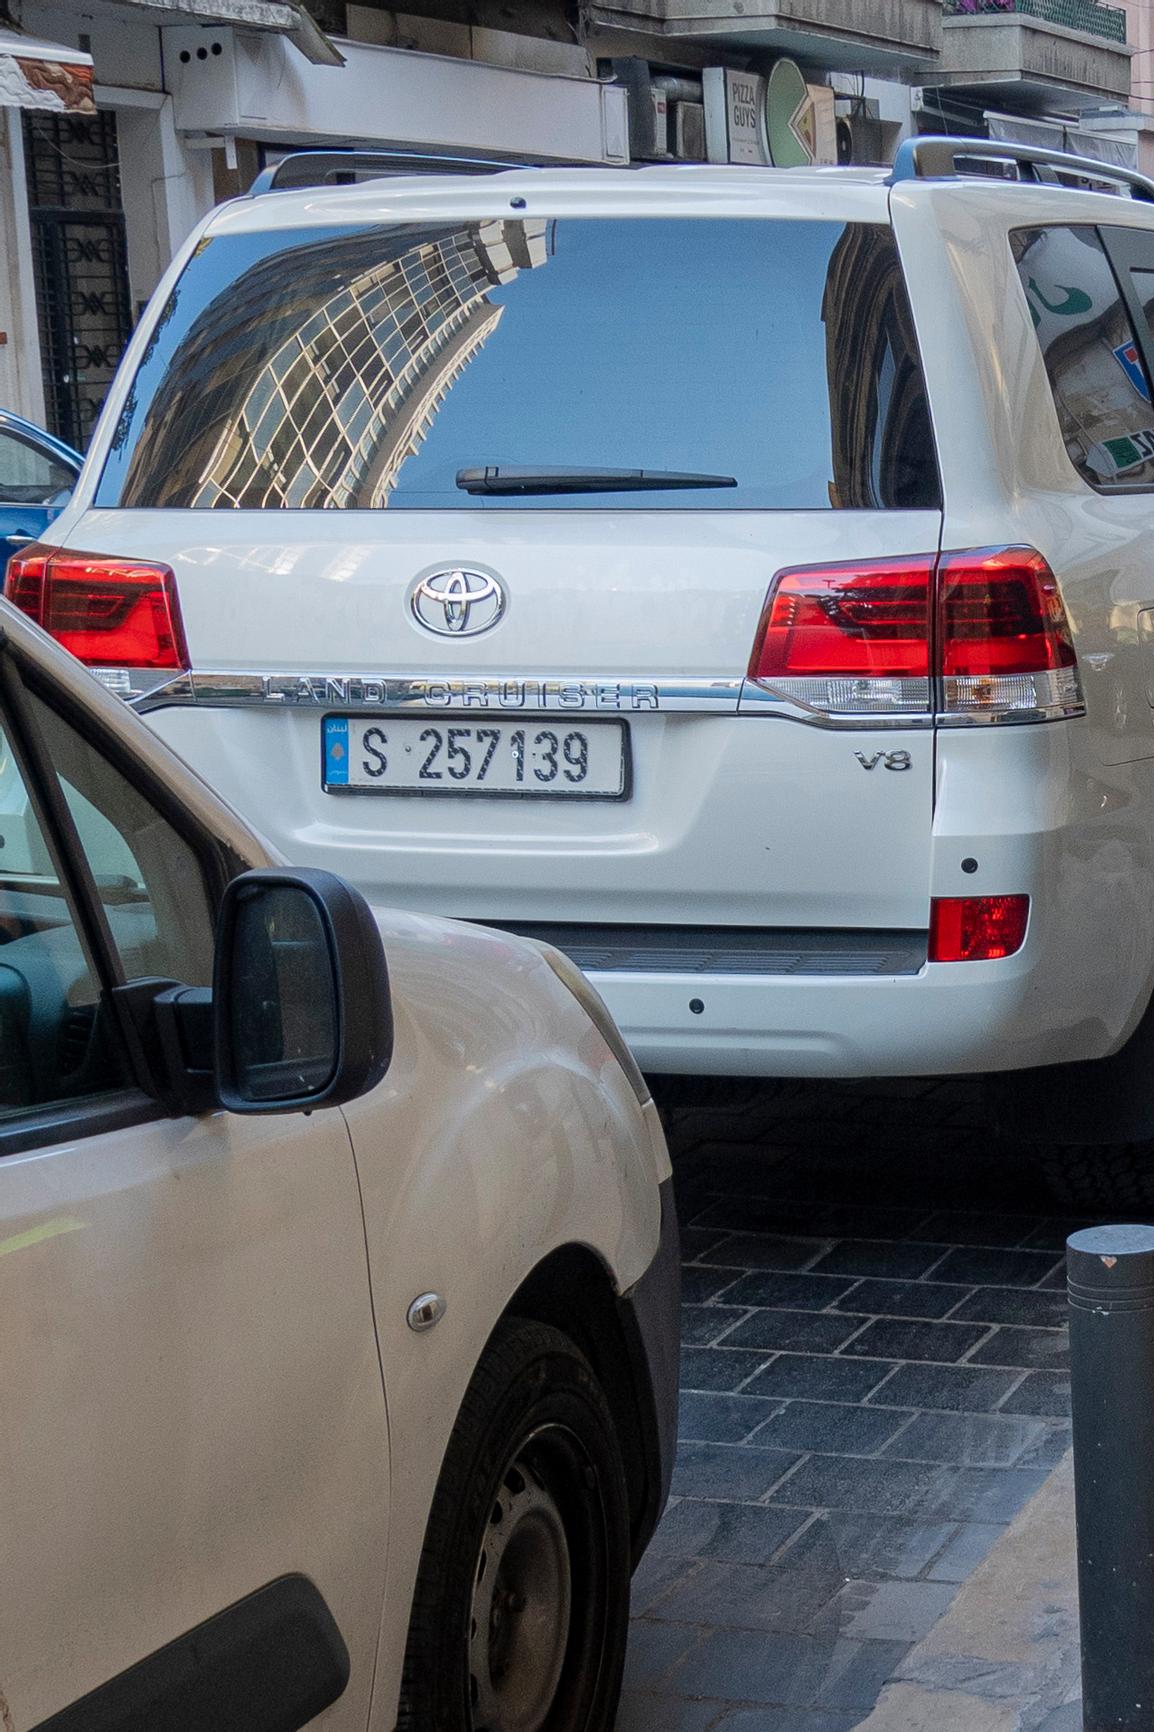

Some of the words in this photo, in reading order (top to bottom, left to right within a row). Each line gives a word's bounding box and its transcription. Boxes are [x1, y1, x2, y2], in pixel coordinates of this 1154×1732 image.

[732, 83, 755, 105] PIZZA
[733, 105, 756, 128] GUYS
[262, 676, 387, 705] LAND
[424, 679, 660, 709] CRUISER
[362, 727, 389, 778] S
[418, 728, 589, 783] 257139
[854, 750, 913, 771] V8
